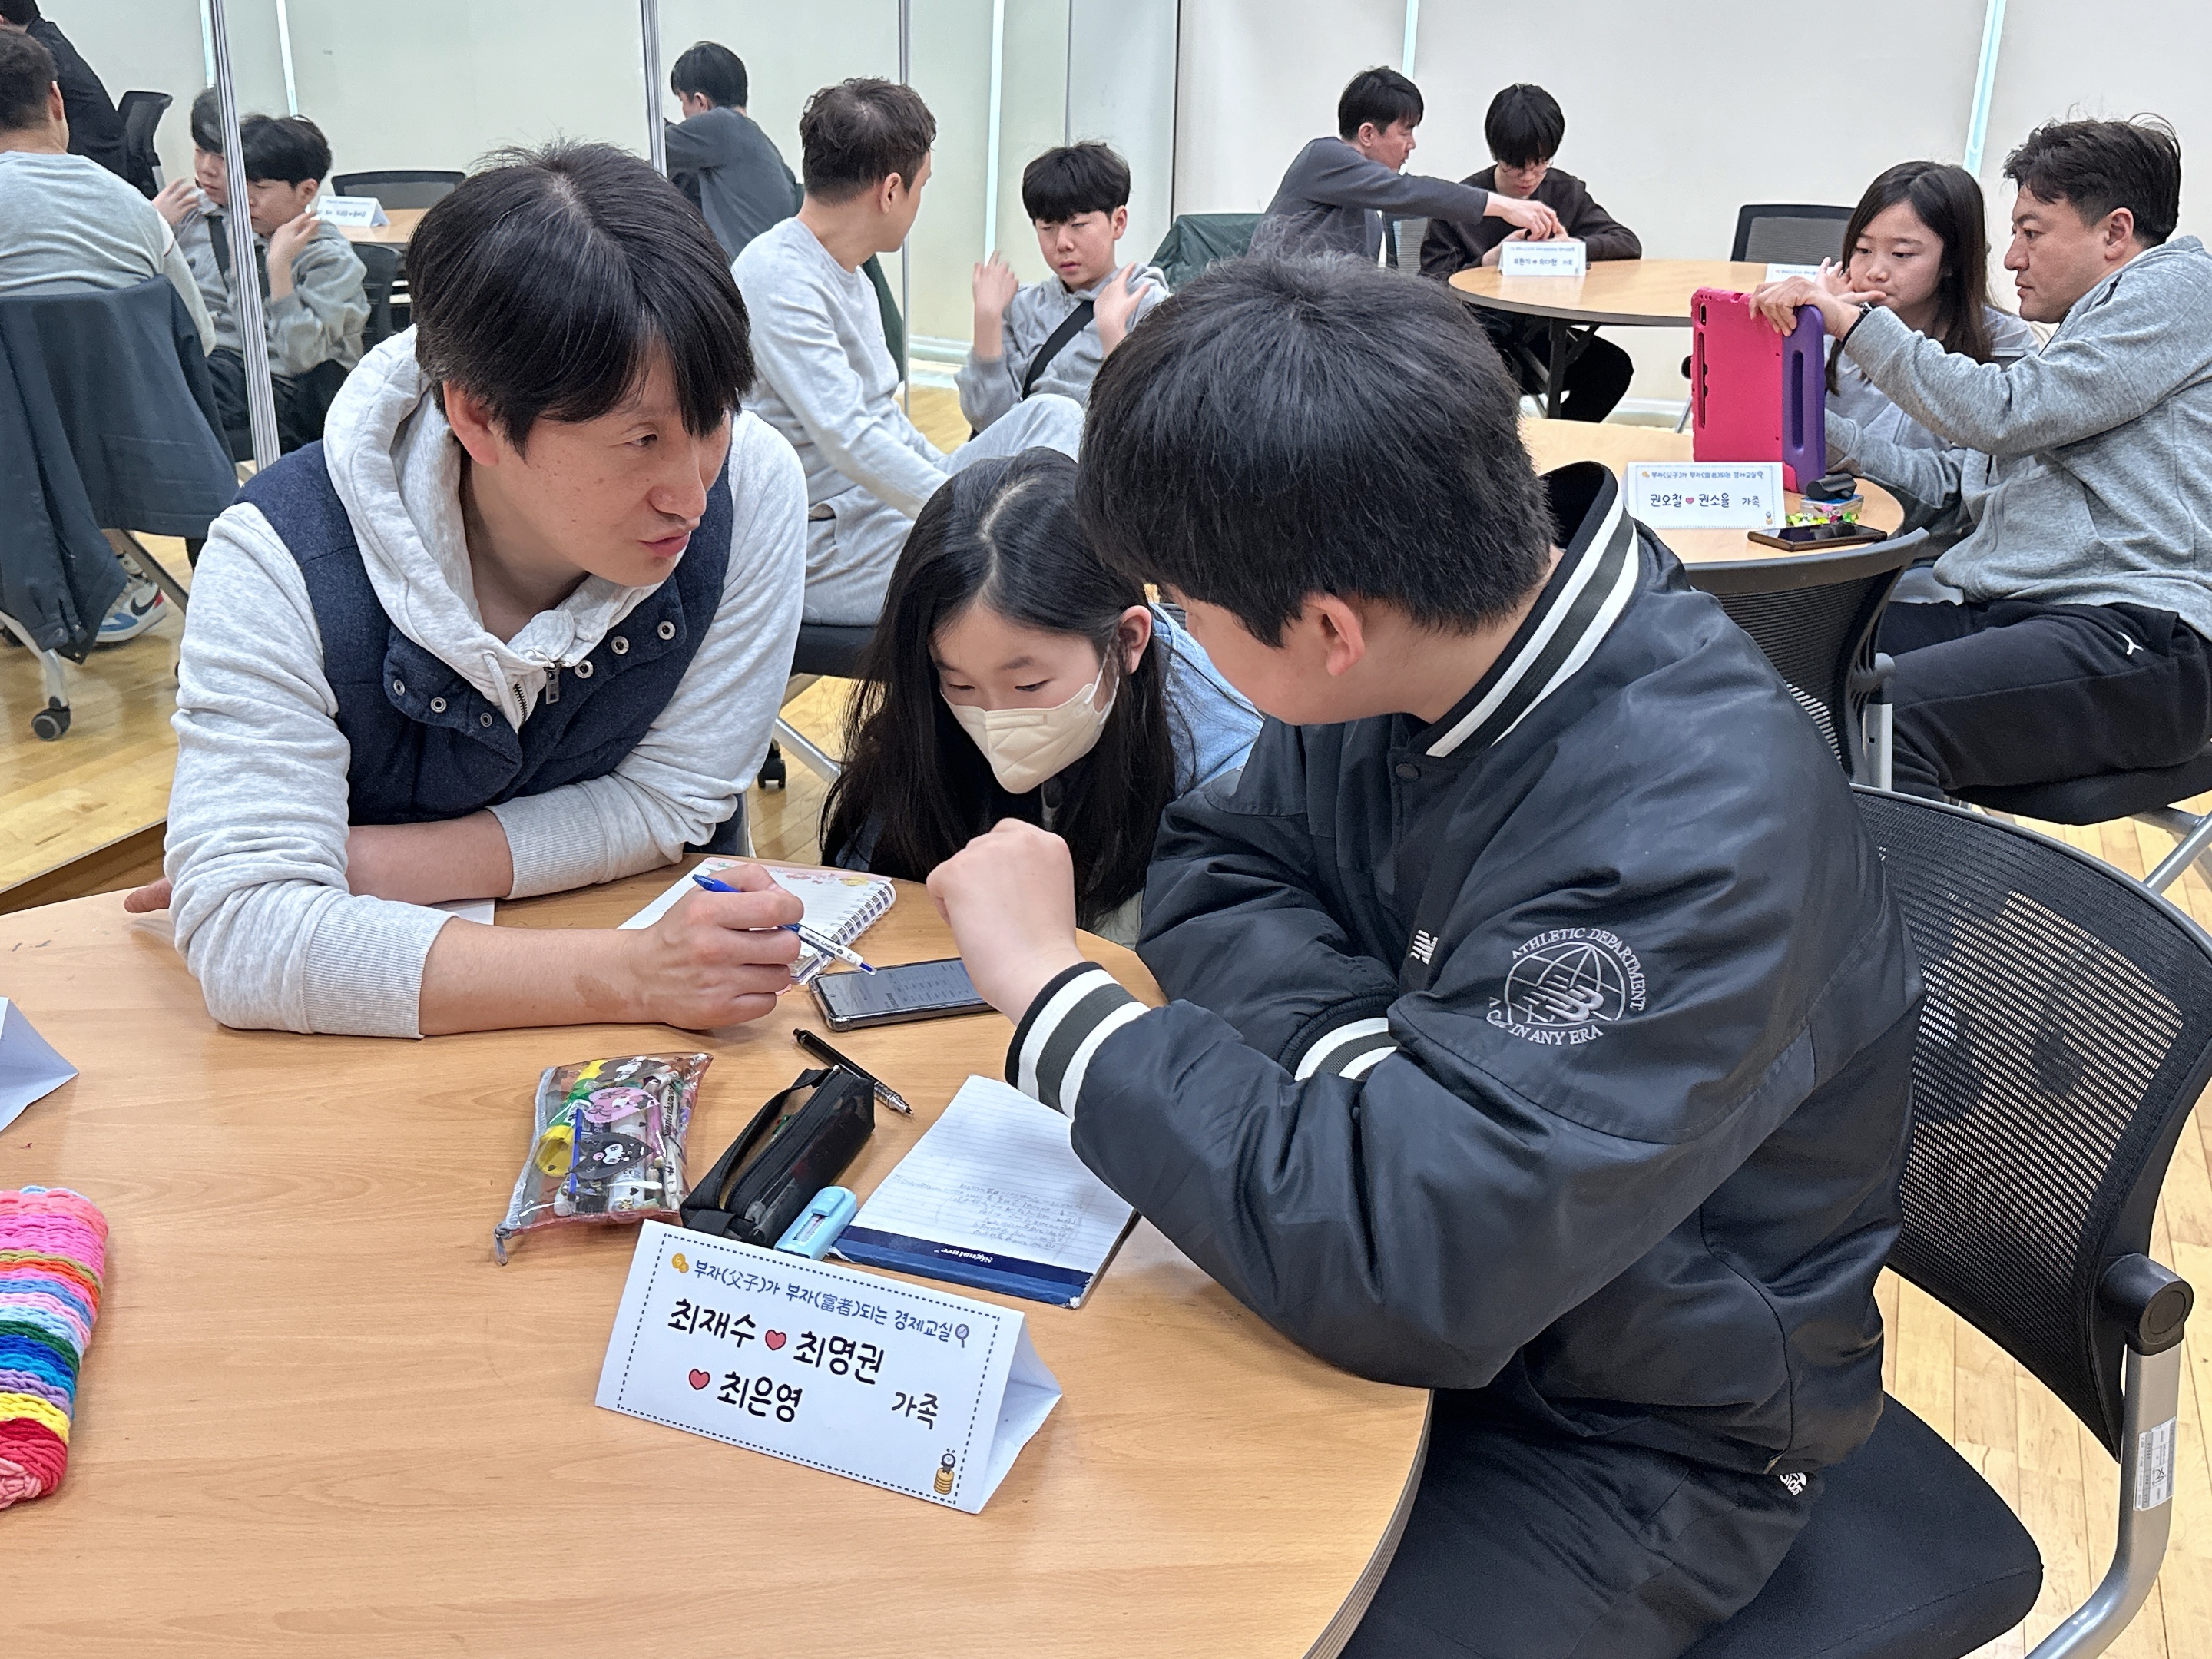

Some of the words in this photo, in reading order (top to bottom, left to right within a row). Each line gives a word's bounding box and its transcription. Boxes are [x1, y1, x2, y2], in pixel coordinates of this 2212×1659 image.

[1698, 492, 1730, 508] 권소율
[1741, 495, 1760, 508] 가족
[1512, 927, 1586, 959] ATHLETIC
[1586, 928, 1647, 1011] DEPARTMENT
[1508, 1023, 1531, 1038] IN
[1528, 1029, 1566, 1045] ANY
[1568, 1025, 1604, 1045] ERA
[694, 1260, 780, 1295] 부자(父子)가
[786, 1283, 889, 1326] 부자(富者)되는
[894, 1309, 954, 1343] 경제교실
[667, 1297, 757, 1349] 최재수
[793, 1330, 885, 1385] 최명권
[717, 1370, 803, 1422] 최은영
[891, 1391, 939, 1430] 가족
